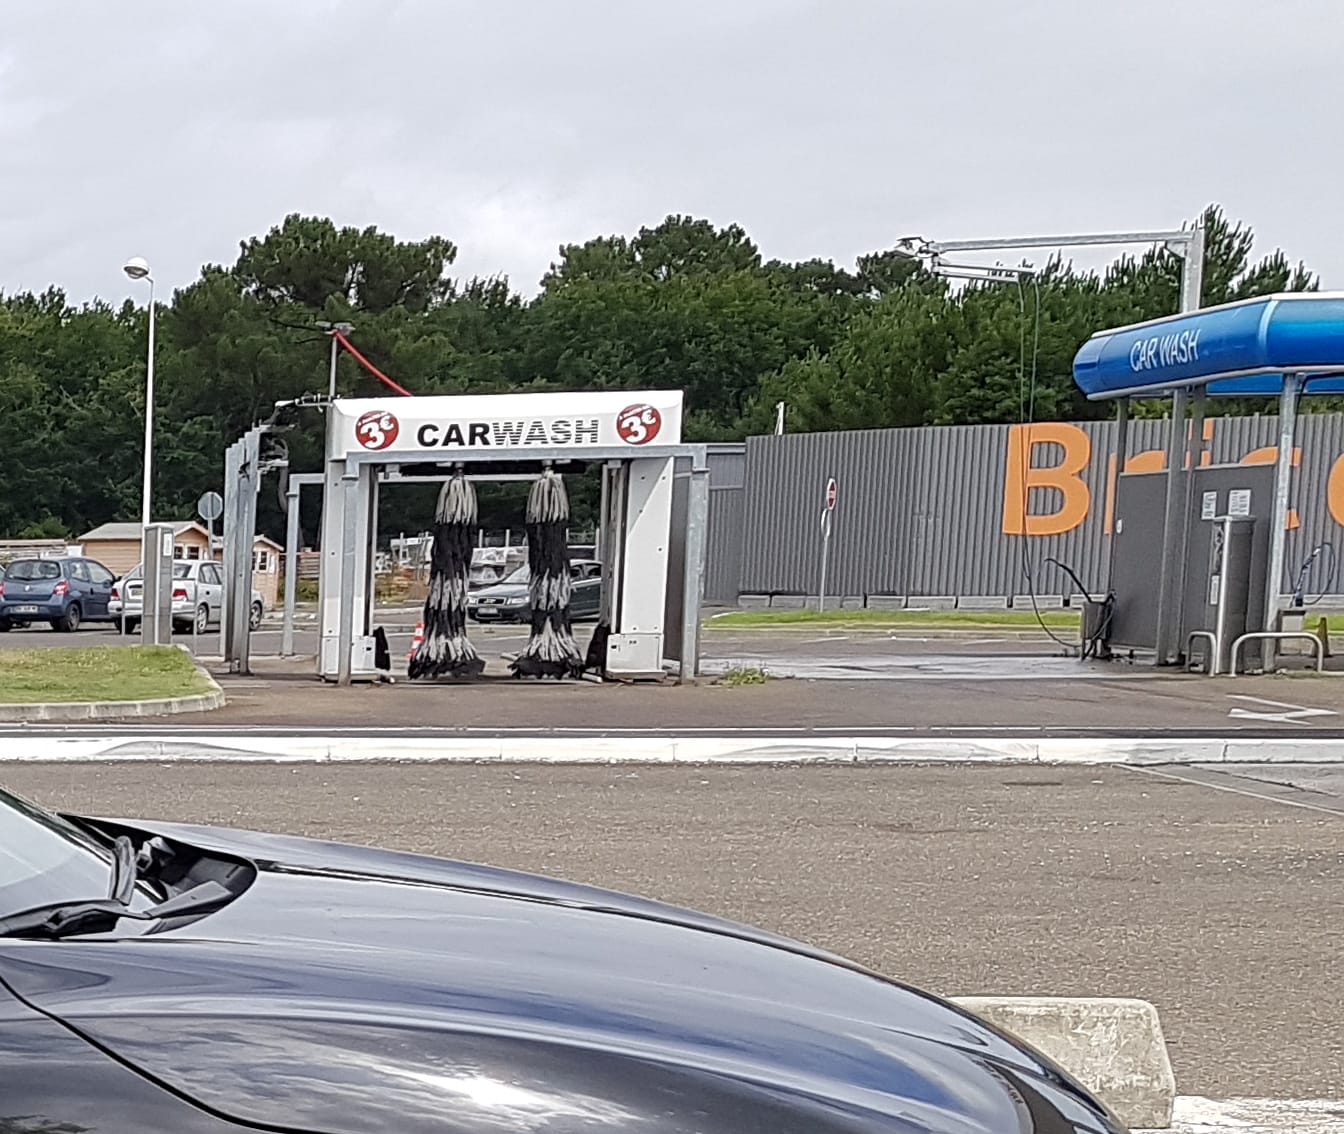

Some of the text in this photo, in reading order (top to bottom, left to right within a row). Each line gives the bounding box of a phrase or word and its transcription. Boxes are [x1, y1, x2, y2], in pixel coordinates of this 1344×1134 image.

[1130, 328, 1201, 372] CAR WASH
[416, 419, 599, 447] CARWASH
